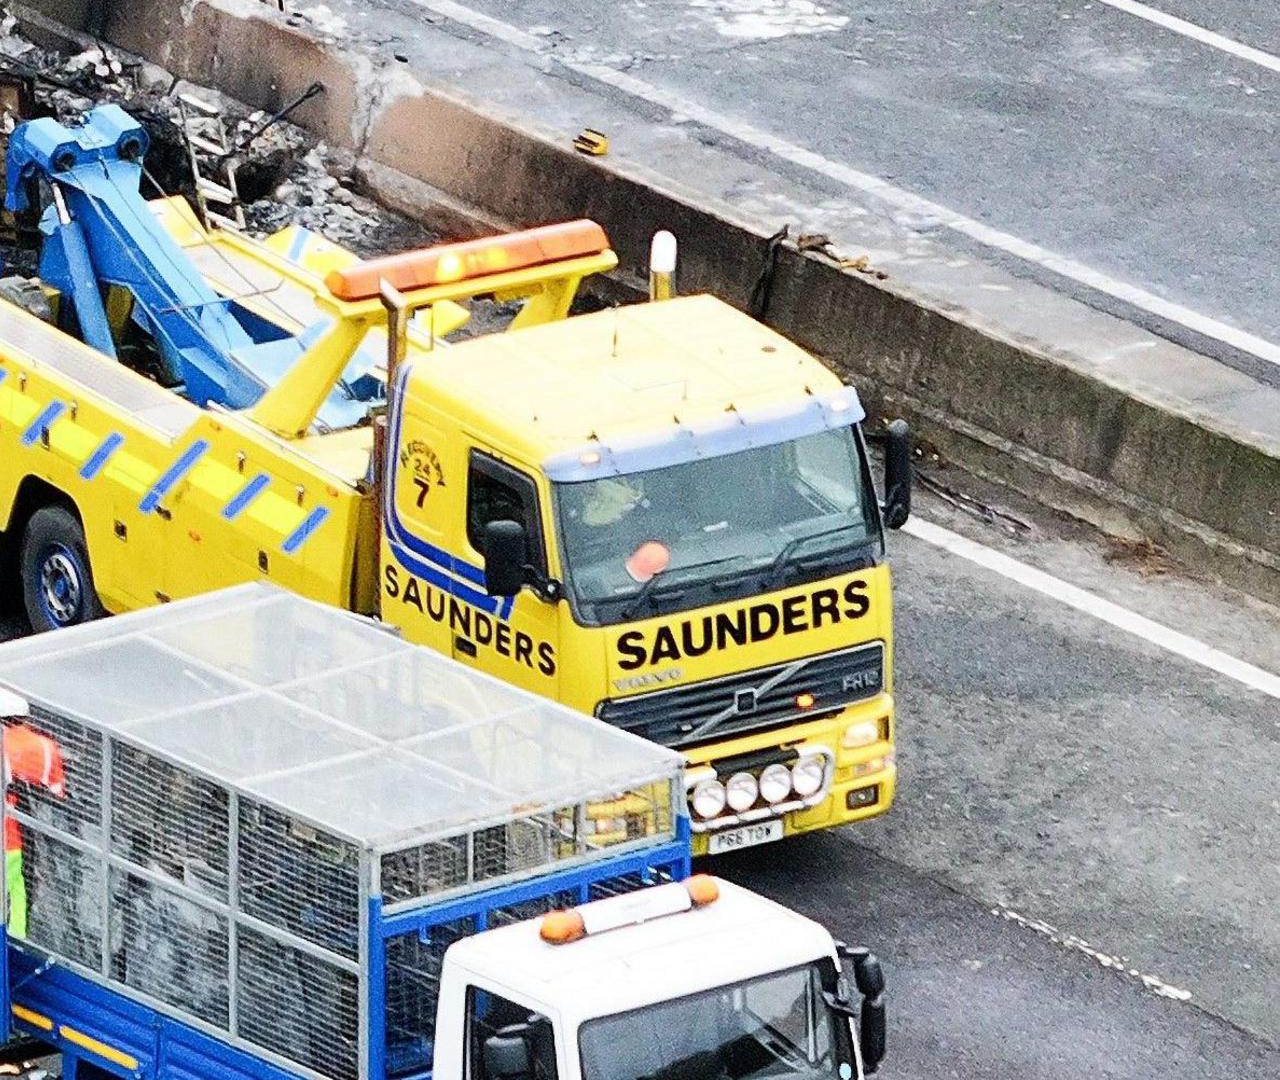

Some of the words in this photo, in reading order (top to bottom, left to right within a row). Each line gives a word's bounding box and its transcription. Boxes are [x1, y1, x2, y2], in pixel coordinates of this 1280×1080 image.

[413, 477, 430, 510] 7
[385, 563, 556, 677] SAUNDERS
[617, 579, 870, 671] SAUNDERS
